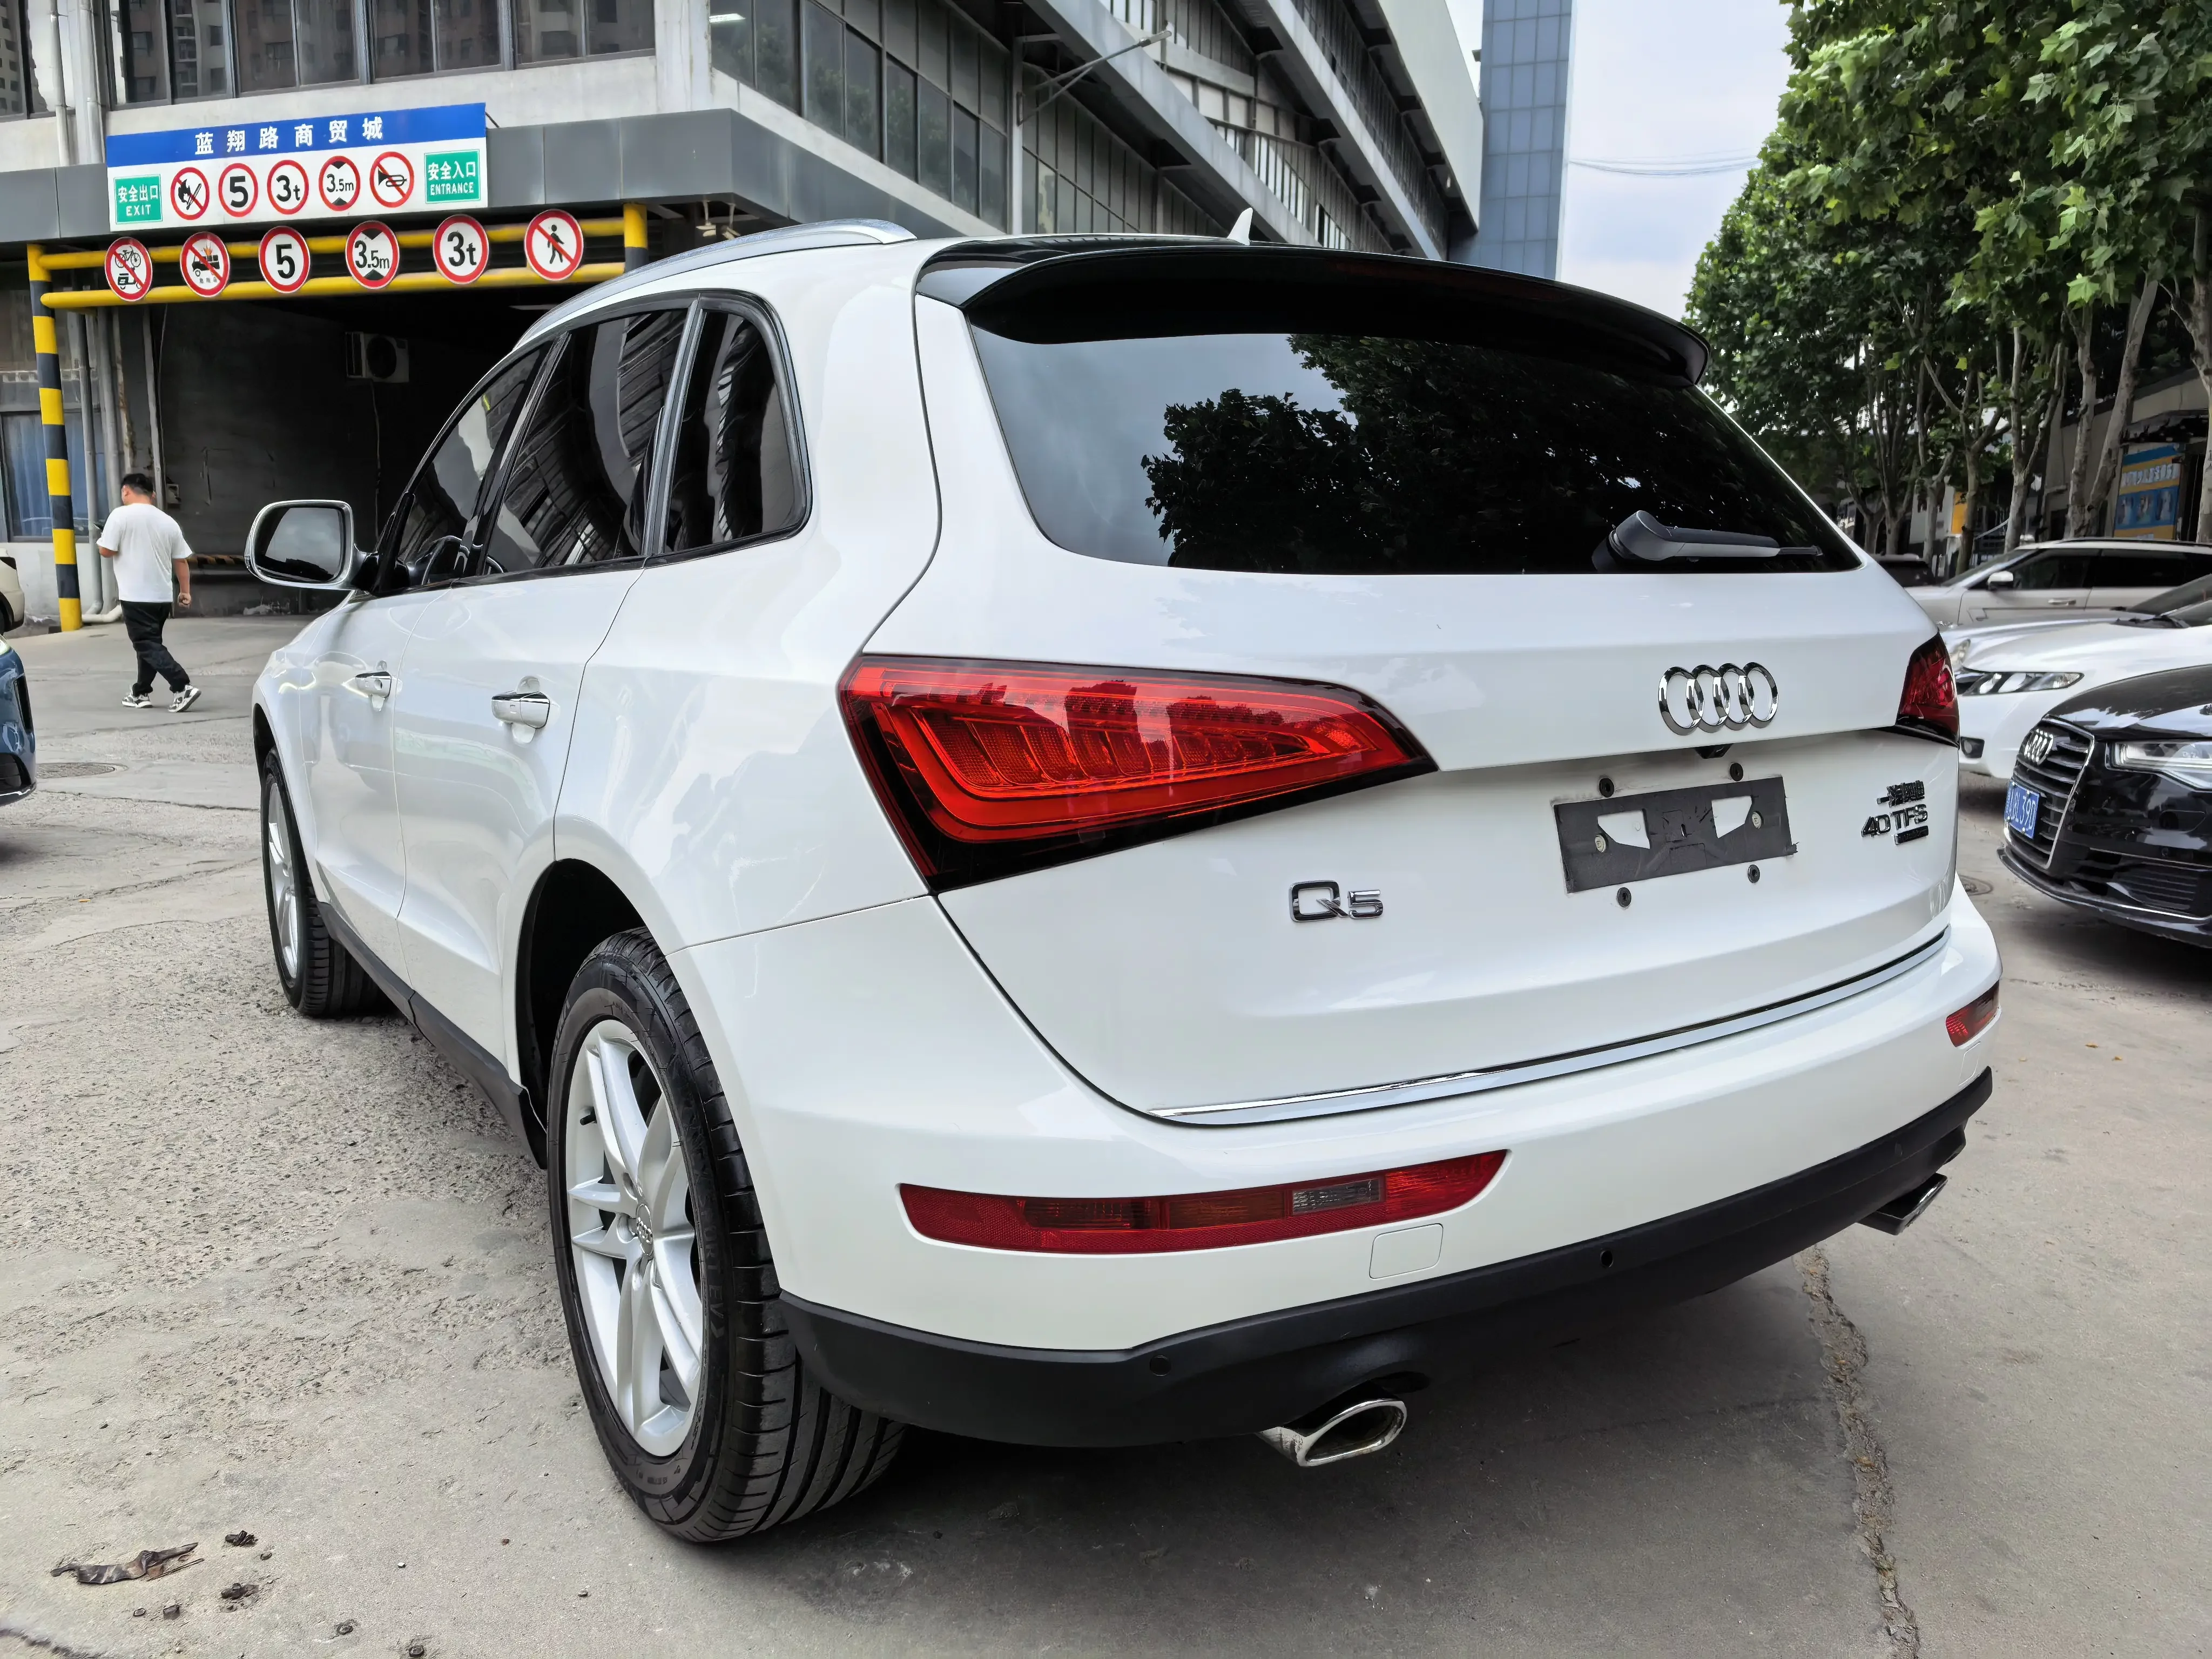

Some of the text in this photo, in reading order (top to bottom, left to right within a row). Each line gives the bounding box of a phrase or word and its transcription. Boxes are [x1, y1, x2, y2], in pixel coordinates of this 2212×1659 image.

[195, 116, 383, 155] 蓝翔路商贸城
[326, 173, 354, 193] 3.5m
[428, 160, 476, 181] 安全入口
[118, 184, 158, 203] 安全出口
[230, 176, 248, 208] 5
[276, 174, 300, 202] 3t
[430, 182, 474, 195] ENTRANCE
[126, 204, 151, 216] EXIT
[275, 244, 295, 279] 5
[354, 240, 390, 269] 3.5m
[447, 231, 477, 267] 3t
[1289, 880, 1384, 922] Q5
